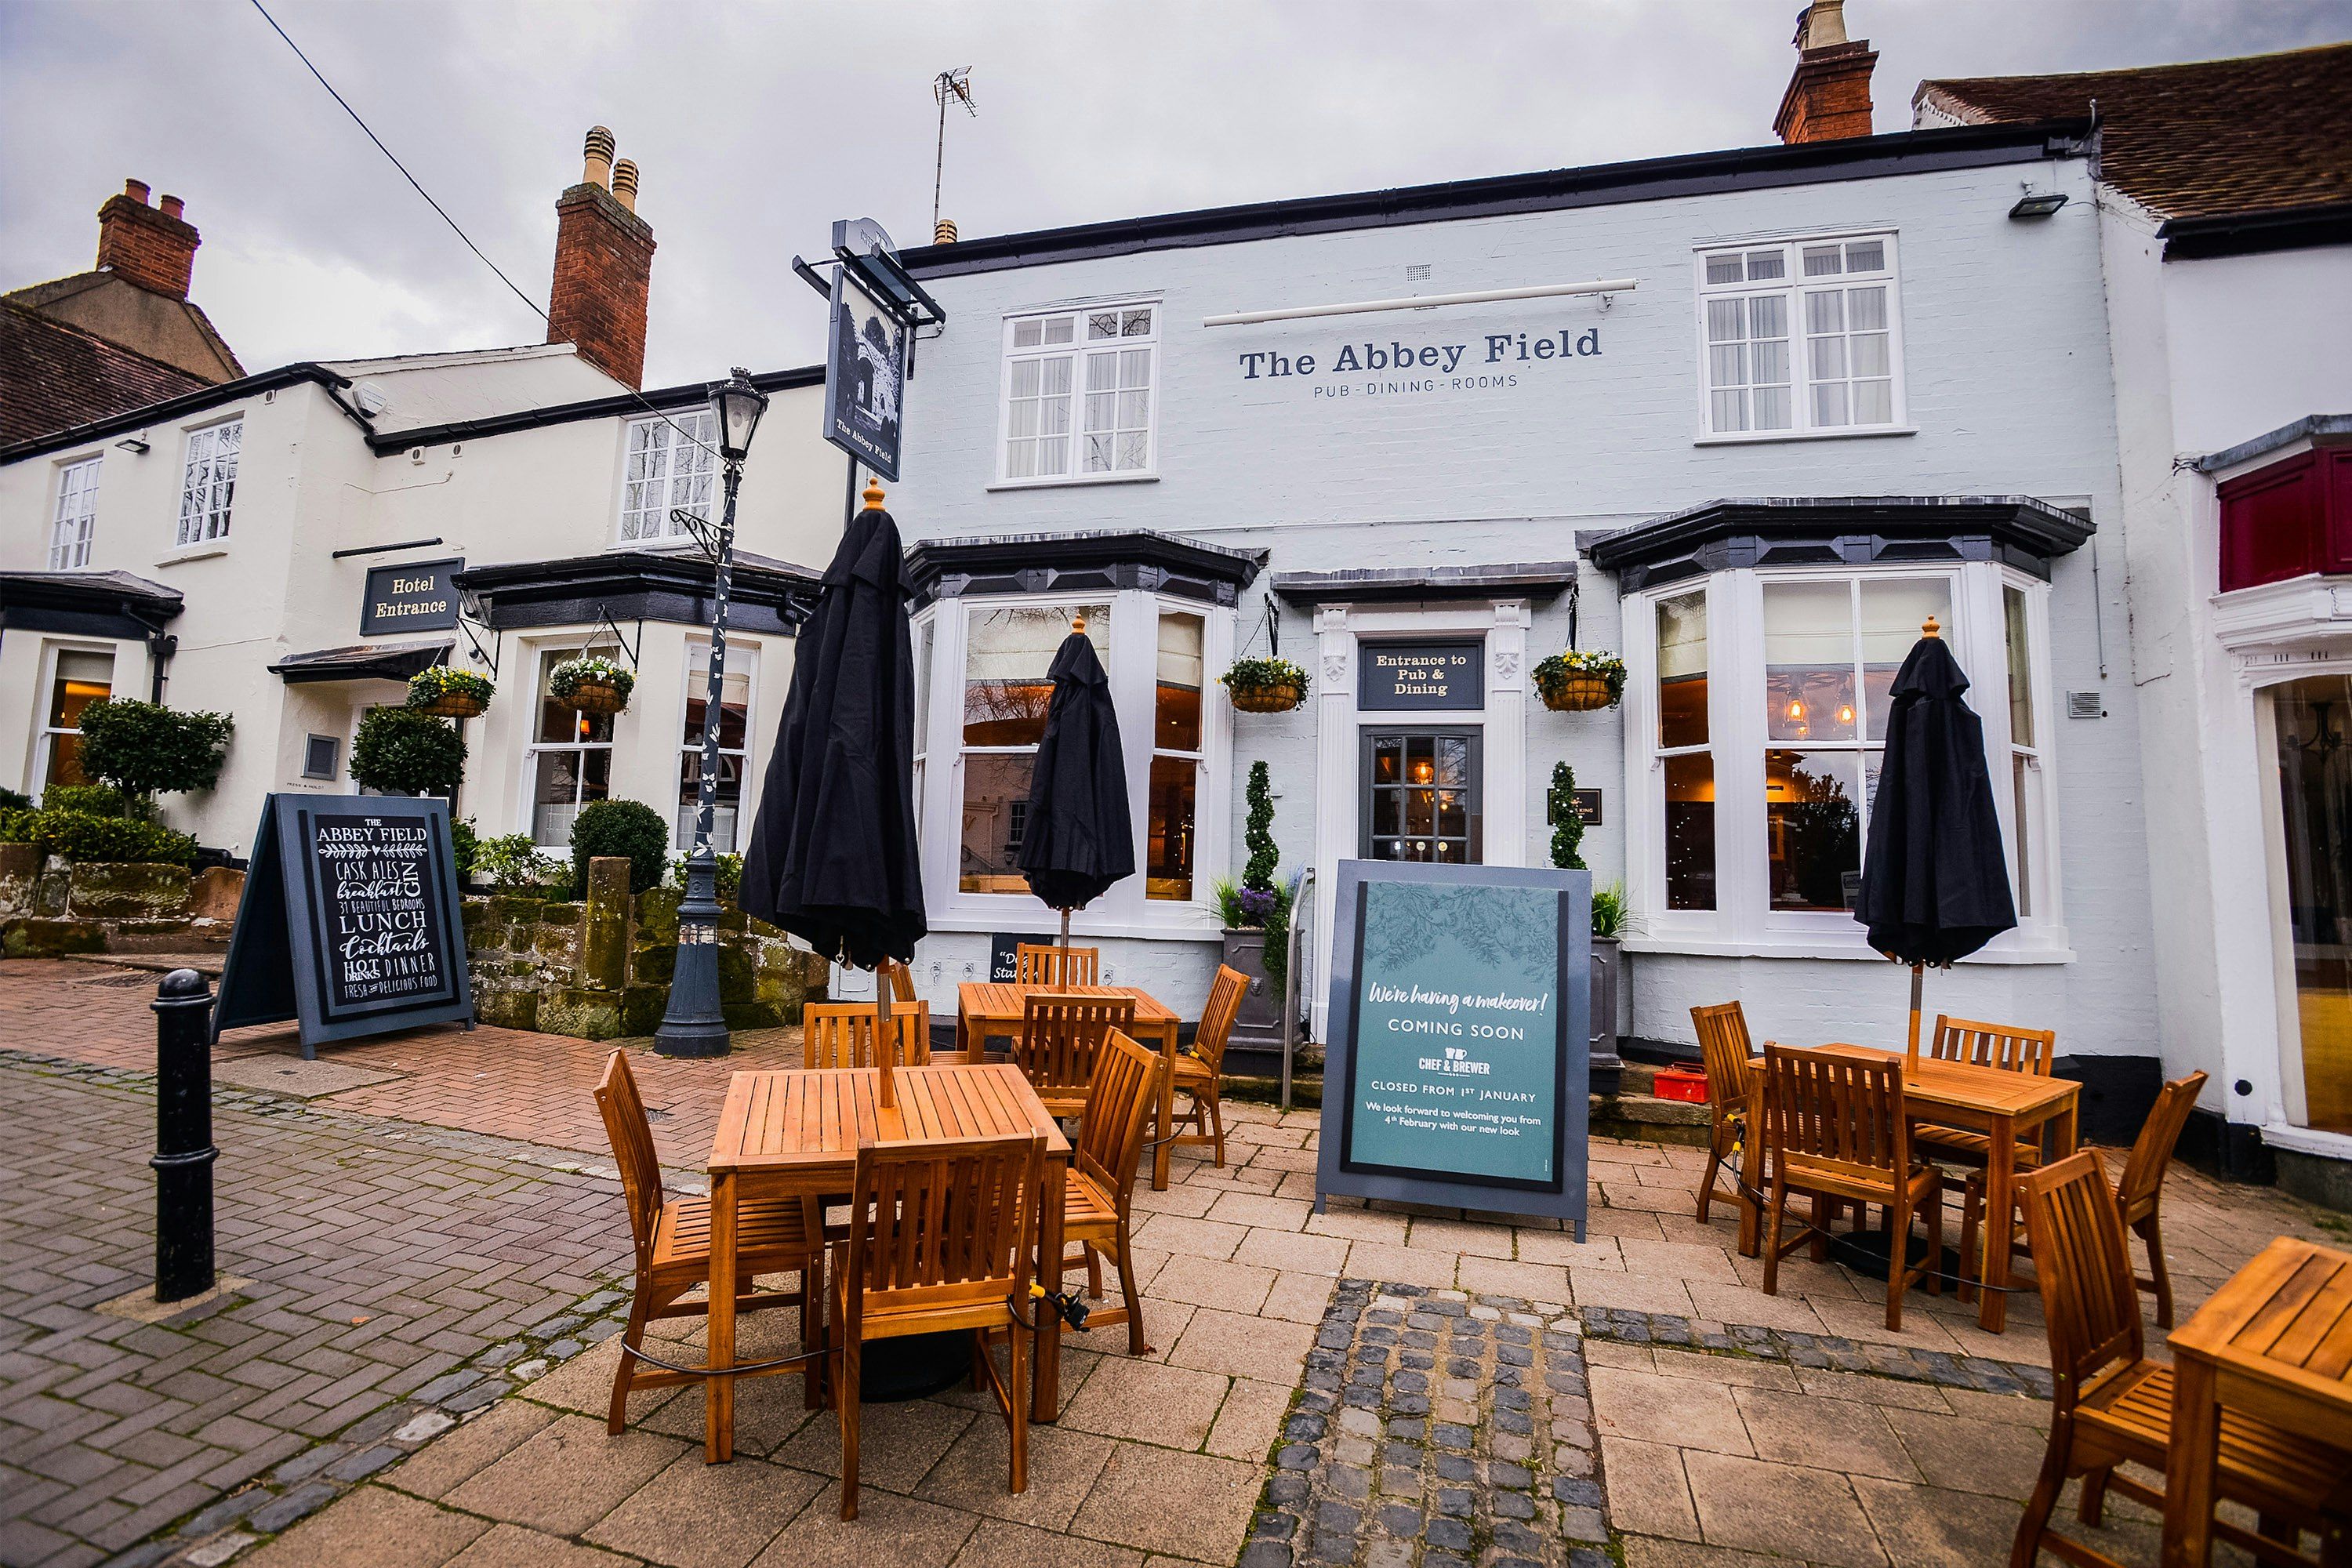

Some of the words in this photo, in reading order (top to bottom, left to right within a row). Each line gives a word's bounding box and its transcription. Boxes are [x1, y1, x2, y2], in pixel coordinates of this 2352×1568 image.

[1240, 351, 1316, 379] The
[1332, 342, 1467, 373] Abbey
[1484, 328, 1602, 363] Field
[837, 418, 851, 435] The
[851, 430, 873, 452] Abbey
[874, 445, 891, 464] Field
[391, 575, 434, 594] Hotel
[375, 600, 447, 619] Entrance
[1376, 655, 1446, 666] Entrance
[1450, 654, 1467, 666] to
[1397, 669, 1427, 681] Pub
[1432, 668, 1445, 680] &
[1394, 683, 1448, 697] Dining
[317, 827, 374, 841] ABBEY
[379, 827, 427, 841] FIELD
[336, 861, 367, 880] CASK
[372, 860, 399, 880] ALES
[401, 862, 421, 897] GIN
[336, 879, 404, 899] breakfast
[339, 901, 349, 915] 31
[351, 899, 390, 913] BEAUTIFUL
[392, 898, 425, 911] BEDROOMS
[339, 910, 426, 934] LUNCH
[339, 928, 430, 960] Cocktails
[343, 959, 379, 973] HOT
[385, 953, 435, 977] DINNER
[993, 967, 1039, 979] Staon
[345, 970, 381, 982] DRINKS
[379, 977, 418, 993] DELICIOUS
[419, 975, 437, 988] FOOD
[1368, 981, 1410, 1003] We're
[1410, 984, 1460, 1014] having
[1461, 995, 1475, 1007] a
[1475, 992, 1548, 1016] makeover!
[1388, 1018, 1463, 1036] COMING
[1470, 1024, 1524, 1040] SOON
[1418, 1058, 1442, 1071] CHEF
[1443, 1060, 1450, 1072] &
[1453, 1060, 1490, 1075] BREWER
[1371, 1080, 1417, 1093] CLOSED
[1422, 1084, 1455, 1096] FROM
[1461, 1087, 1475, 1097] 1ST
[1479, 1090, 1536, 1103] JANUARY
[1365, 1102, 1381, 1112] We
[1383, 1103, 1403, 1113] look
[1404, 1105, 1438, 1117] forward
[1441, 1109, 1450, 1118] to
[1453, 1110, 1499, 1124] welcoming
[1501, 1116, 1517, 1125] you
[1519, 1115, 1541, 1125] from
[1385, 1116, 1397, 1124] 4th
[1399, 1116, 1437, 1131] February
[1439, 1121, 1458, 1131] with
[1461, 1124, 1477, 1133] our
[1500, 1126, 1520, 1137] look
